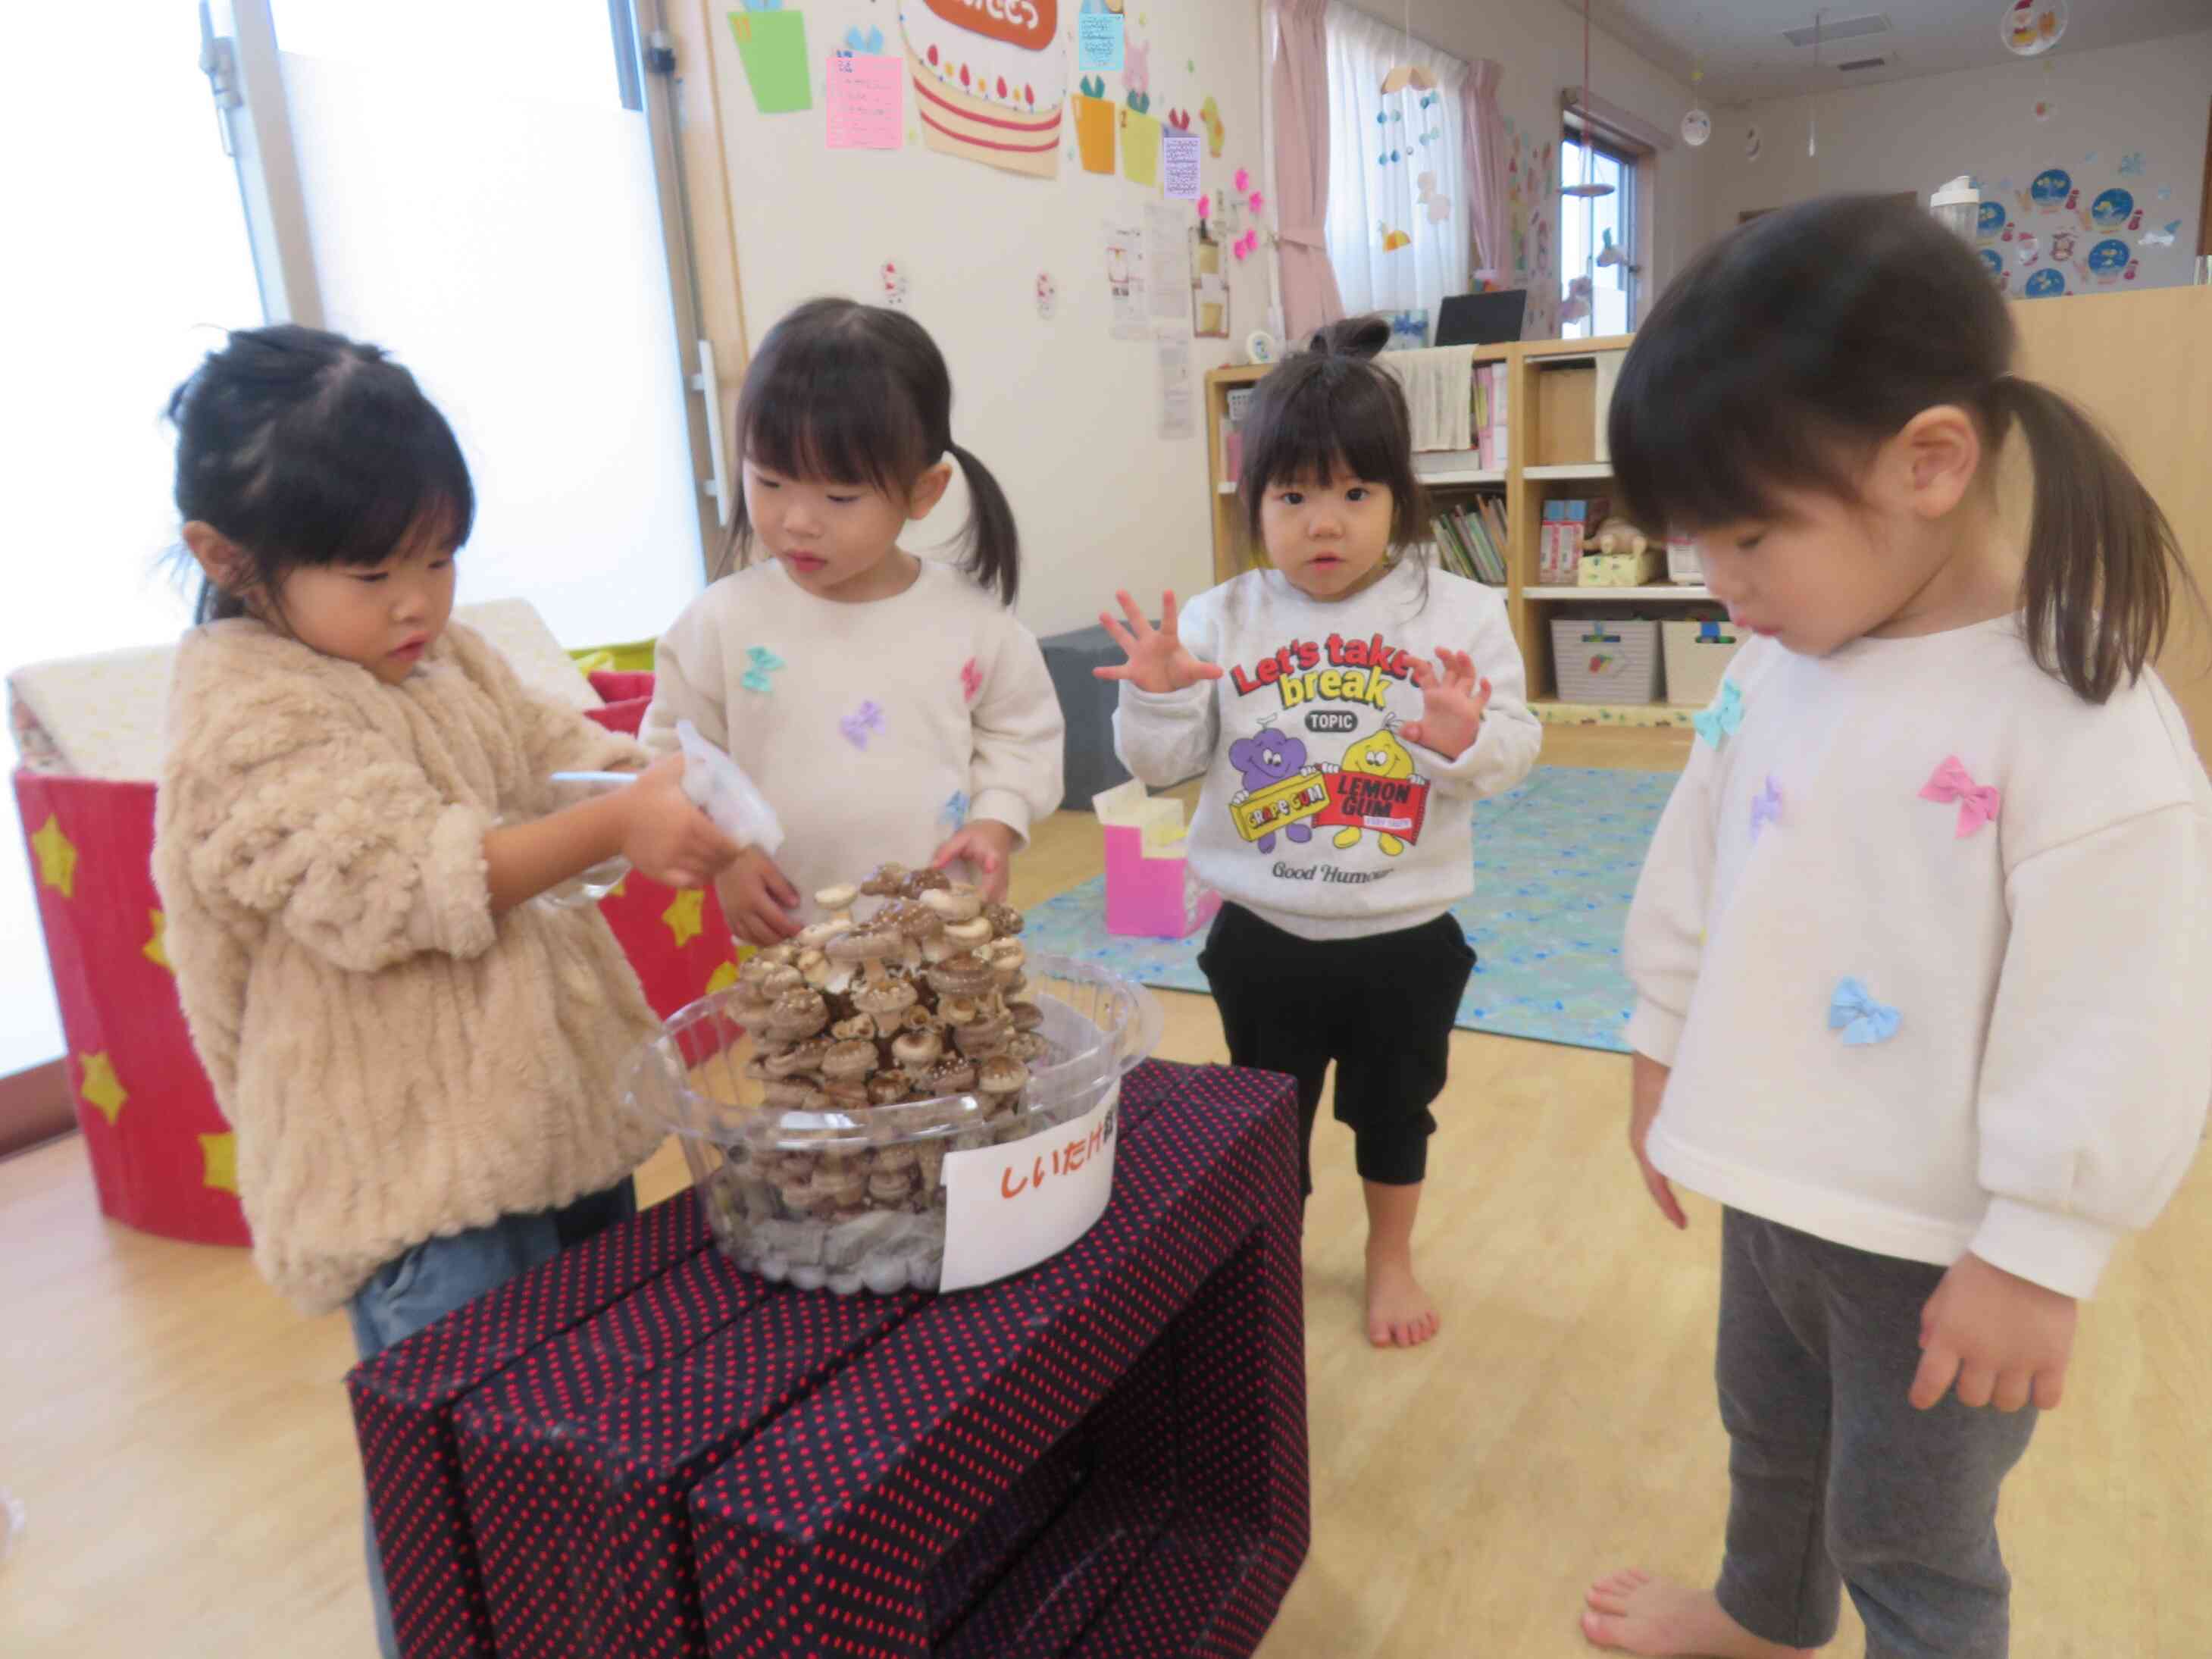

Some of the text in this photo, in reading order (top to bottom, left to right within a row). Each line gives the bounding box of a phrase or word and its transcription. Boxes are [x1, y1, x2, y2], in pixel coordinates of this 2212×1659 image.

[1230, 639, 1319, 696] Let's
[1279, 667, 1392, 709] break
[1311, 715, 1353, 728] TOPIC
[1291, 784, 1324, 810] GUM
[1338, 776, 1409, 803] LEMON
[1343, 797, 1391, 818] GUM
[1272, 862, 1317, 880] Good
